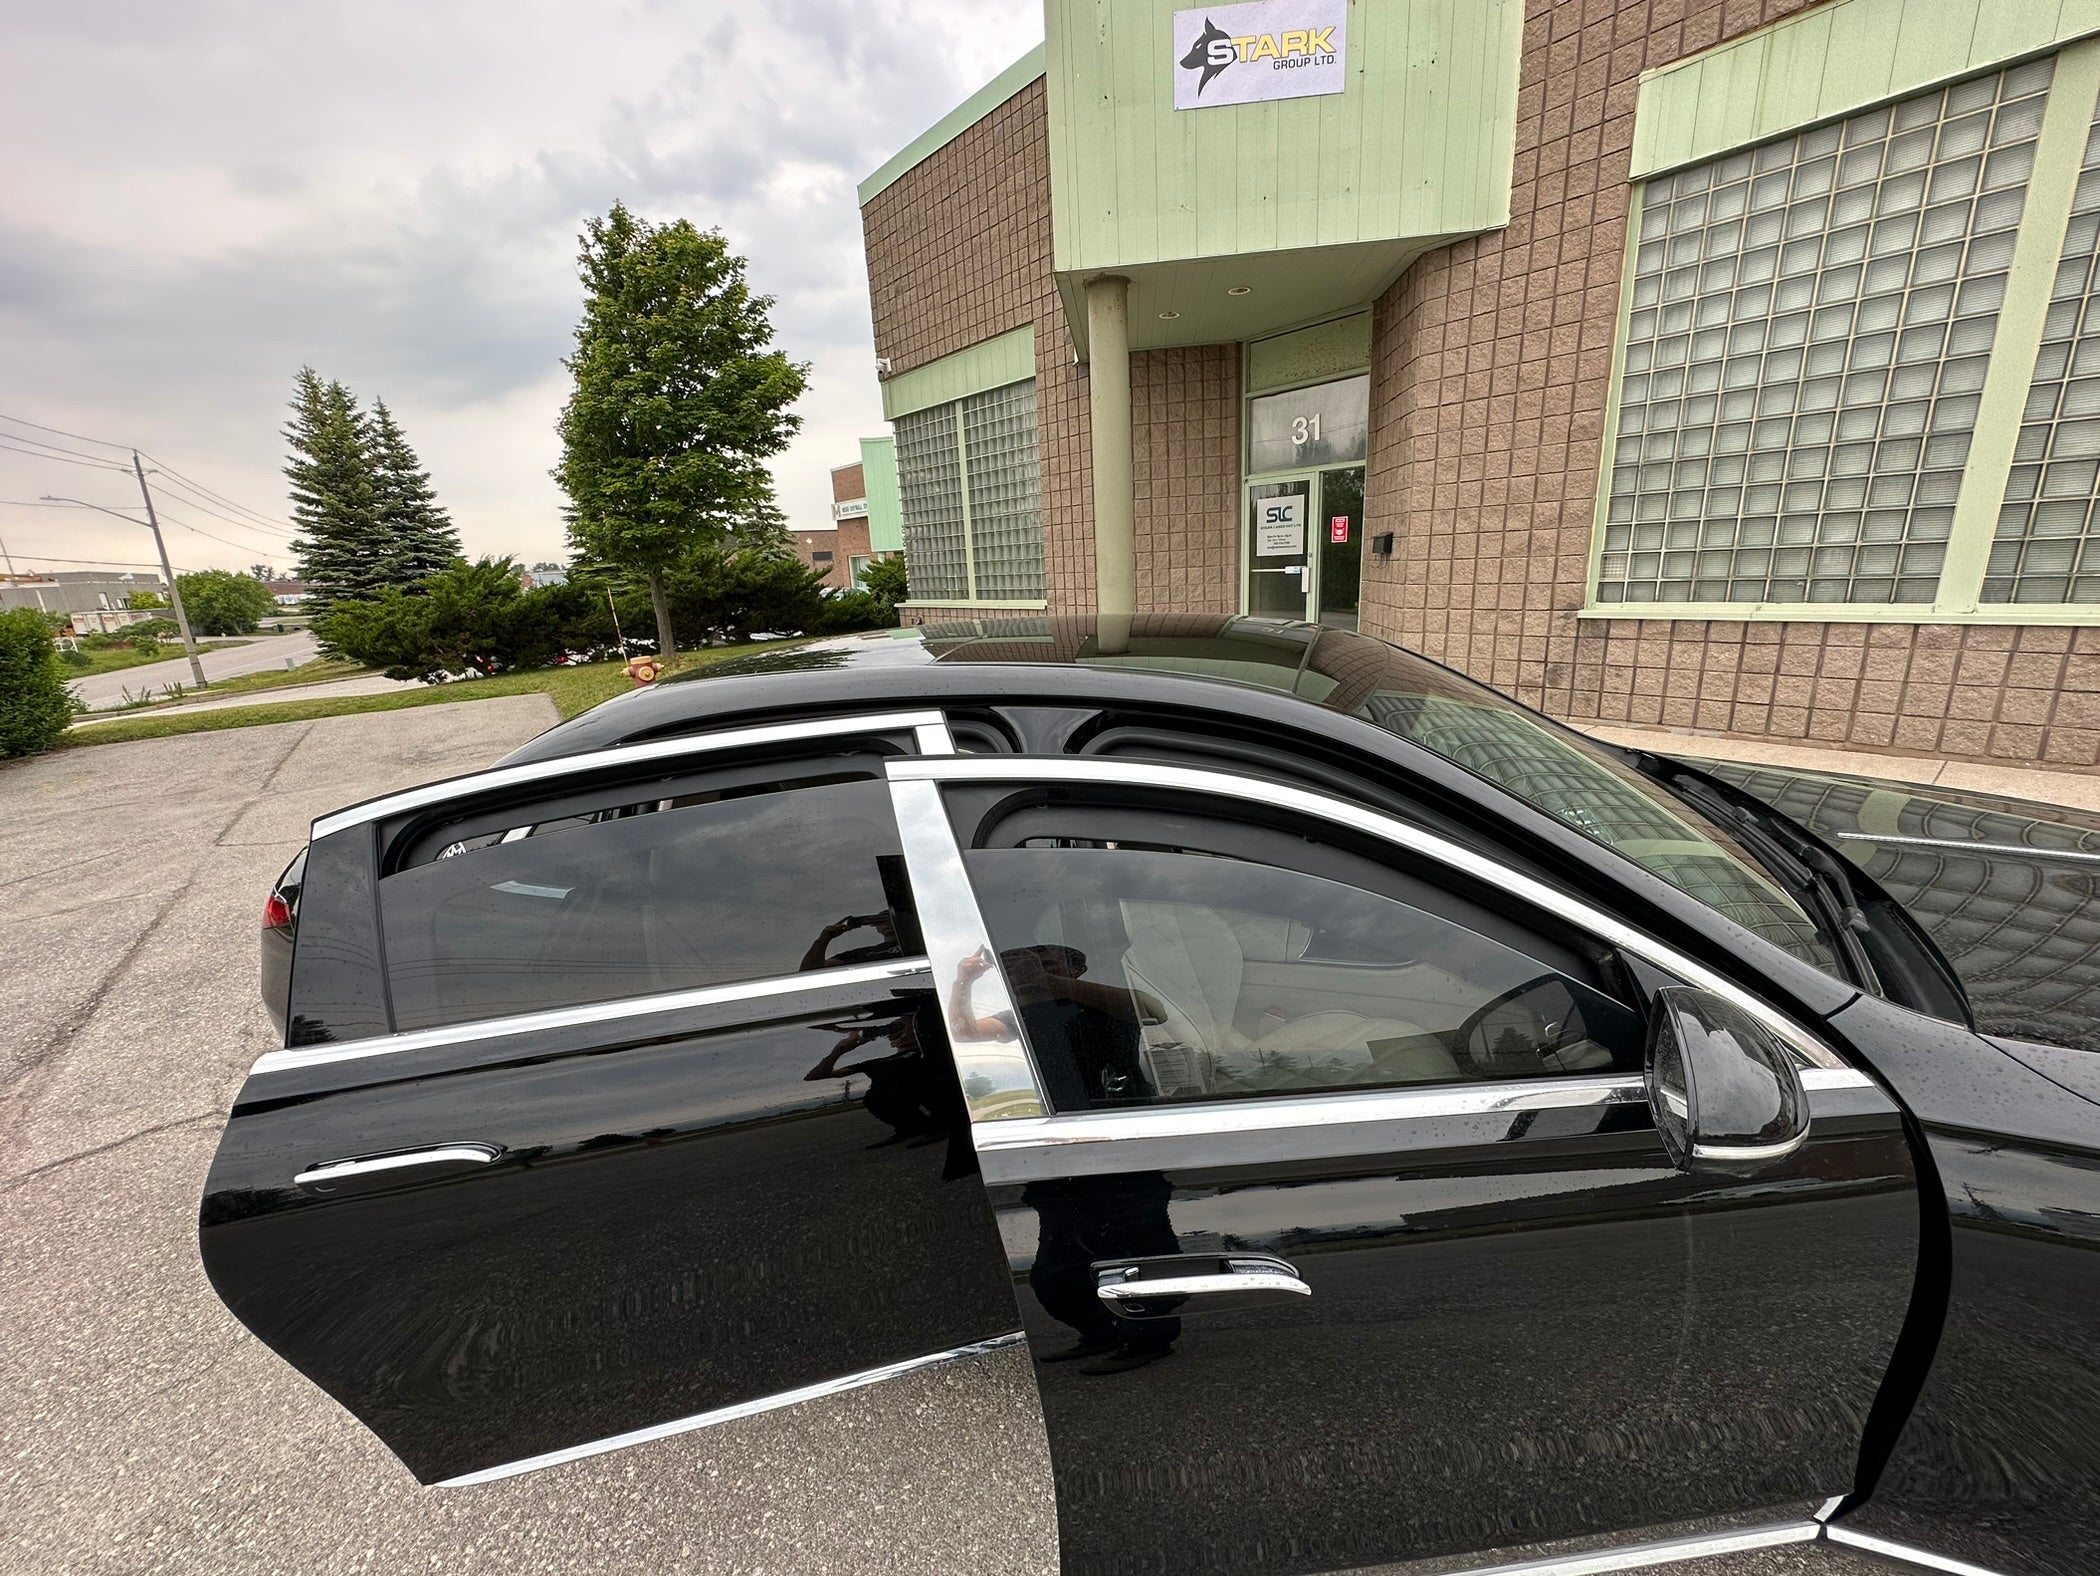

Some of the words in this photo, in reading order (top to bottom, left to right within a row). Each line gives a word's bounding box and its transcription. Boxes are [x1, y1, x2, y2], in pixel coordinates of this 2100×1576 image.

[1207, 26, 1337, 66] STARK
[1273, 57, 1311, 70] GROUP
[1314, 54, 1337, 66] LTD.
[1291, 413, 1321, 445] 31
[1266, 505, 1293, 523] SLC
